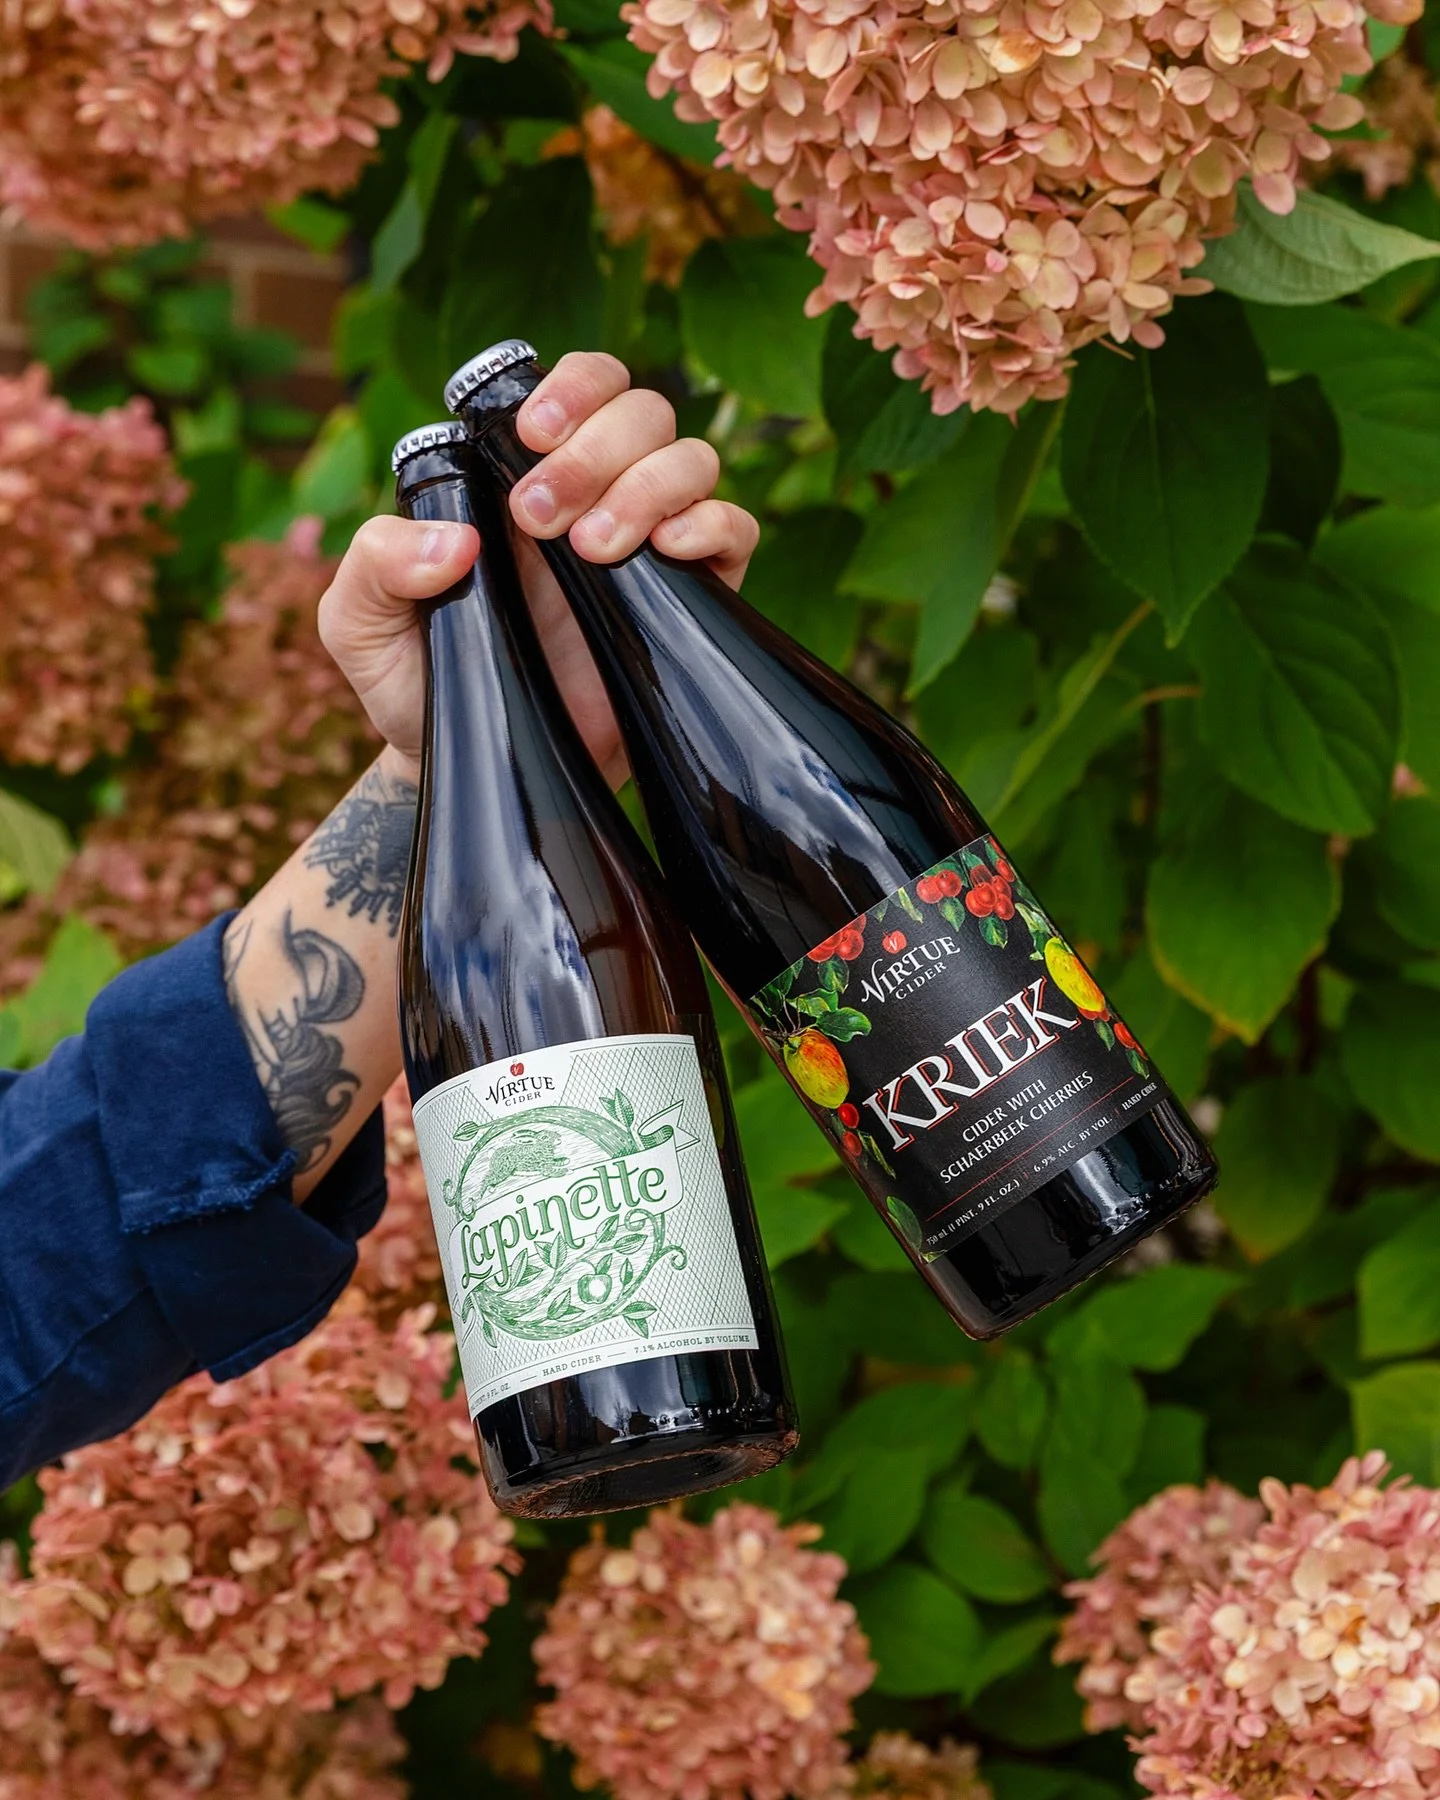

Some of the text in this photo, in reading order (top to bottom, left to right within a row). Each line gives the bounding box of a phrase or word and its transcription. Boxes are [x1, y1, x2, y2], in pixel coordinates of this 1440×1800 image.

[861, 936, 961, 1003] VIRTUE
[895, 961, 947, 1000] CIDER
[485, 1076, 556, 1105] VIRTUE
[862, 975, 1083, 1153] KRIEK
[504, 1091, 542, 1107] CIDER
[939, 1070, 1095, 1184] SCHAERBEEK CHERRIES
[962, 1079, 1047, 1143] CIDER WITH
[977, 1203, 985, 1211] 9
[984, 1195, 1000, 1207] FL.
[999, 1179, 1020, 1196] OZ.)
[1033, 1154, 1057, 1173] 6.9%
[1057, 1139, 1079, 1157] ALC.
[1078, 1128, 1092, 1142] BY
[1091, 1116, 1113, 1132] VOL.
[1121, 1093, 1142, 1110] HARD
[461, 1159, 668, 1290] Lapinette
[542, 1362, 568, 1377] HARD
[570, 1354, 602, 1369] CIDER
[634, 1343, 655, 1354] 7.1%
[657, 1336, 703, 1350] ALCOHOL
[704, 1335, 716, 1345] BY
[716, 1334, 750, 1343] VOLUME
